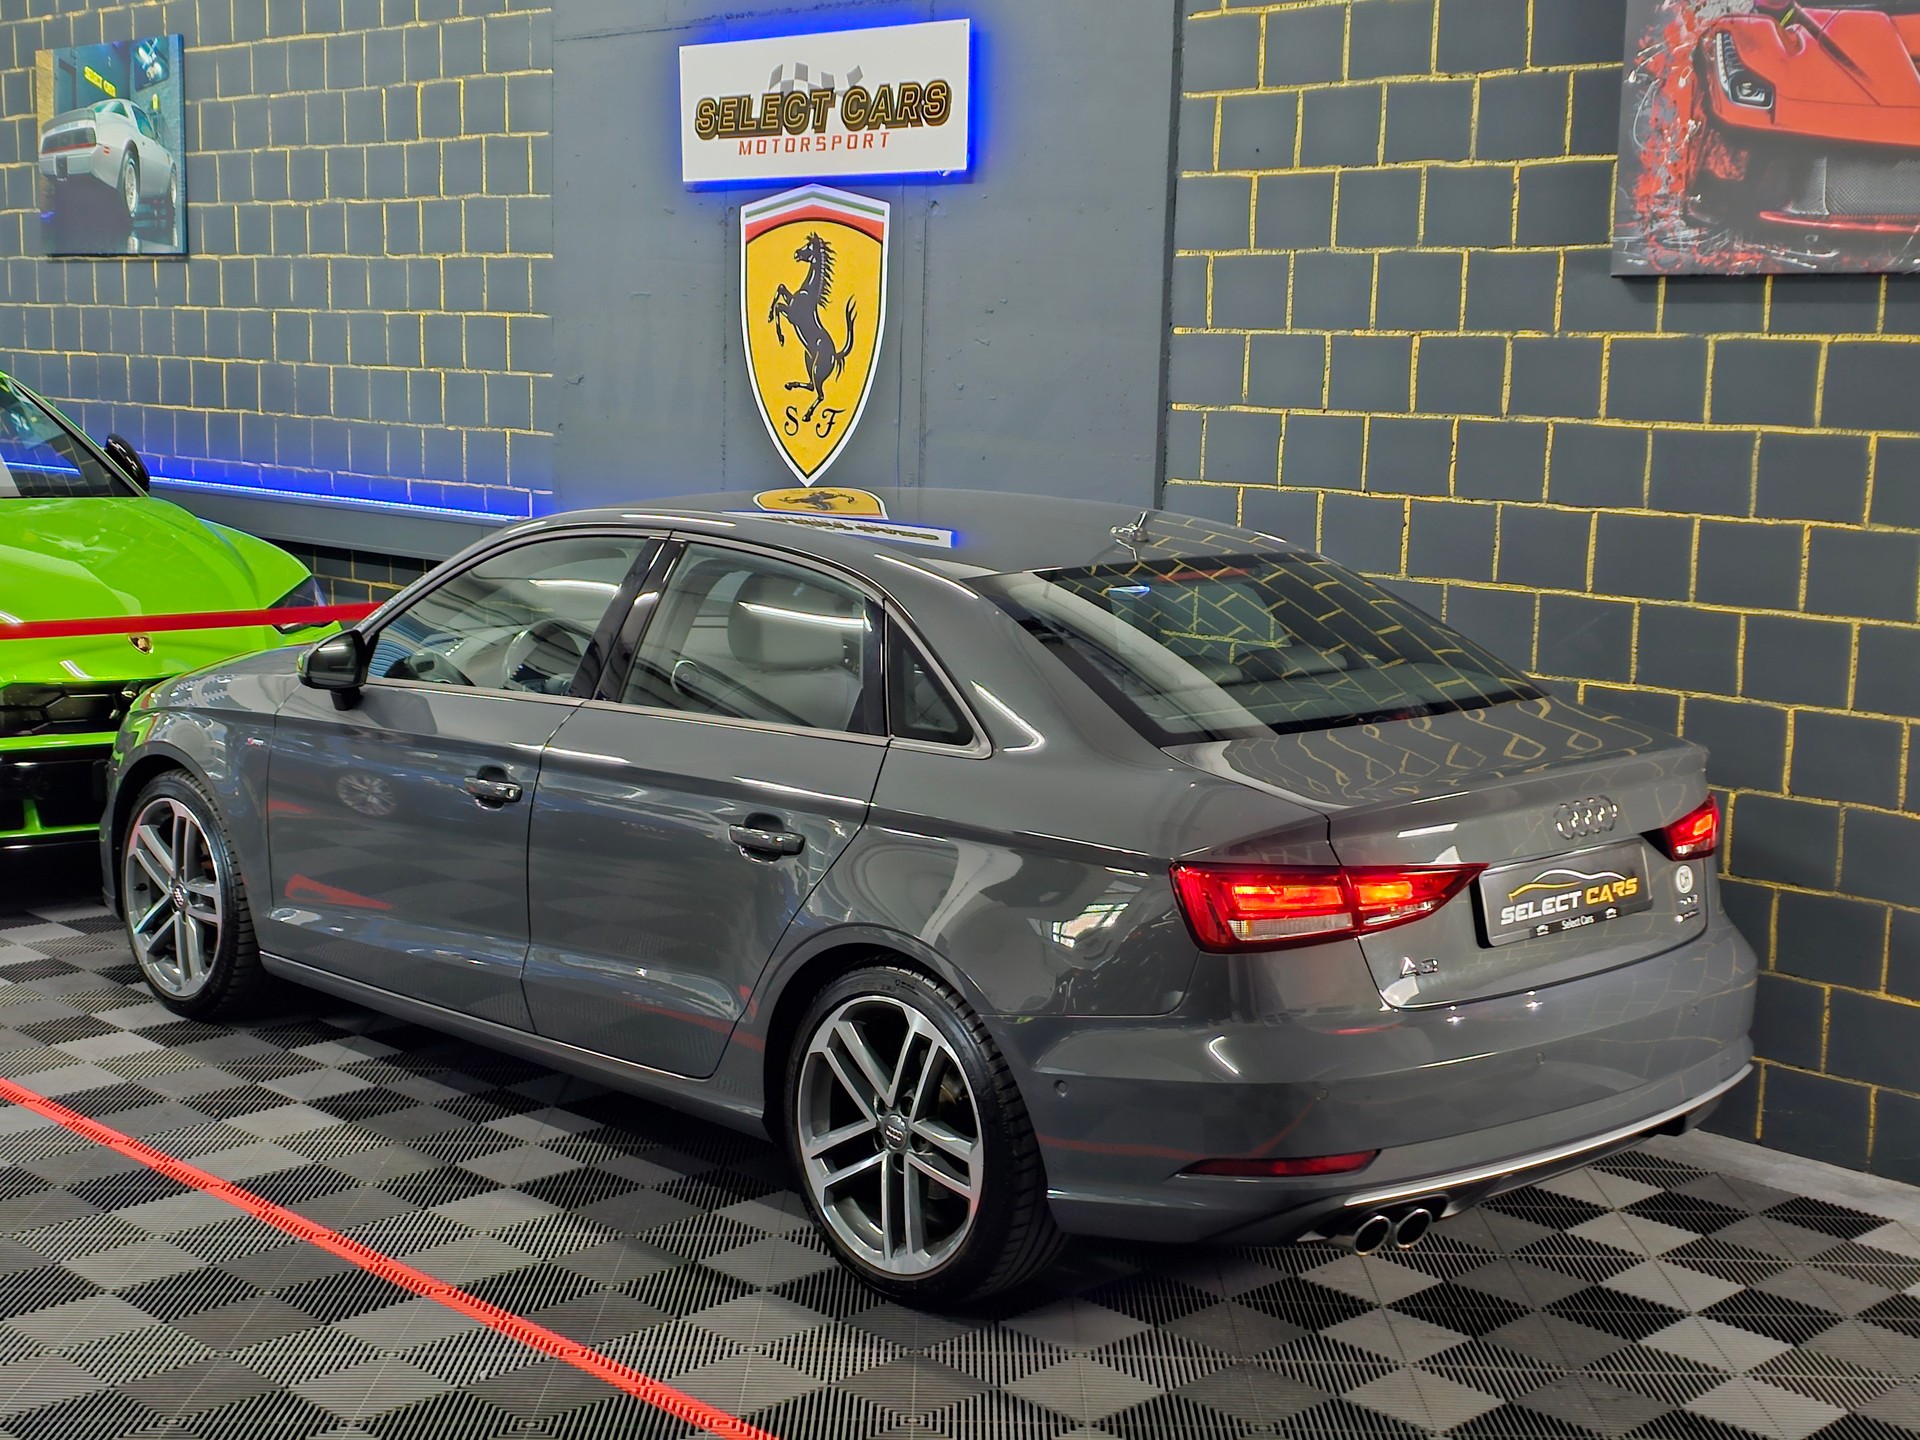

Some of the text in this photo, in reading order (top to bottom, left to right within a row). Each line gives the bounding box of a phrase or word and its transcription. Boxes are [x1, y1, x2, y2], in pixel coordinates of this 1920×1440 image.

[696, 79, 952, 139] SELECT CARS
[738, 132, 891, 155] MOTORSPORT
[784, 406, 846, 438] S F
[1500, 877, 1638, 926] SELECT CARS
[1561, 915, 1595, 930] Select Cars
